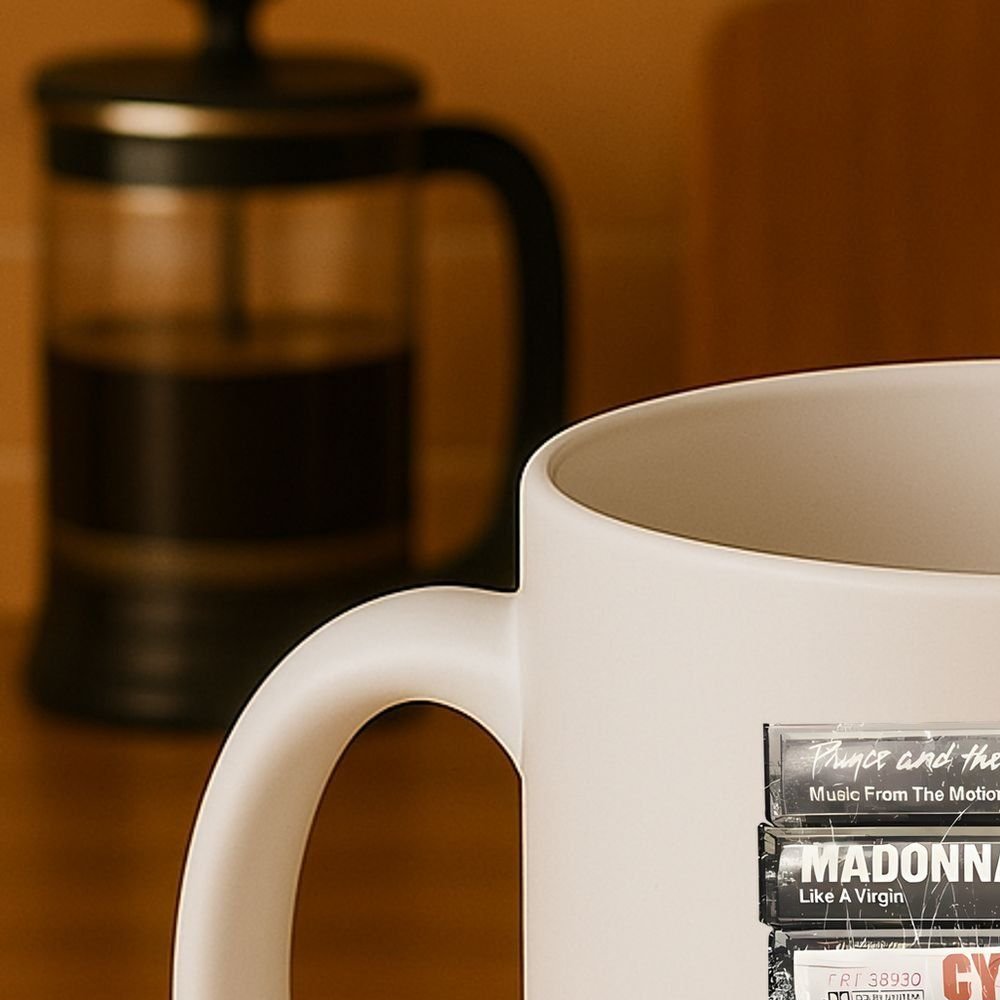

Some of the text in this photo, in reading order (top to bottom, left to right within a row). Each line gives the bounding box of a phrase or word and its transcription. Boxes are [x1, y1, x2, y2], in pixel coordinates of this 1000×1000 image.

[896, 742, 954, 773] and
[809, 786, 860, 802] Music
[865, 786, 908, 802] From
[912, 786, 945, 802] The
[799, 888, 904, 907] Like A Virgin
[868, 972, 922, 988] 38930
